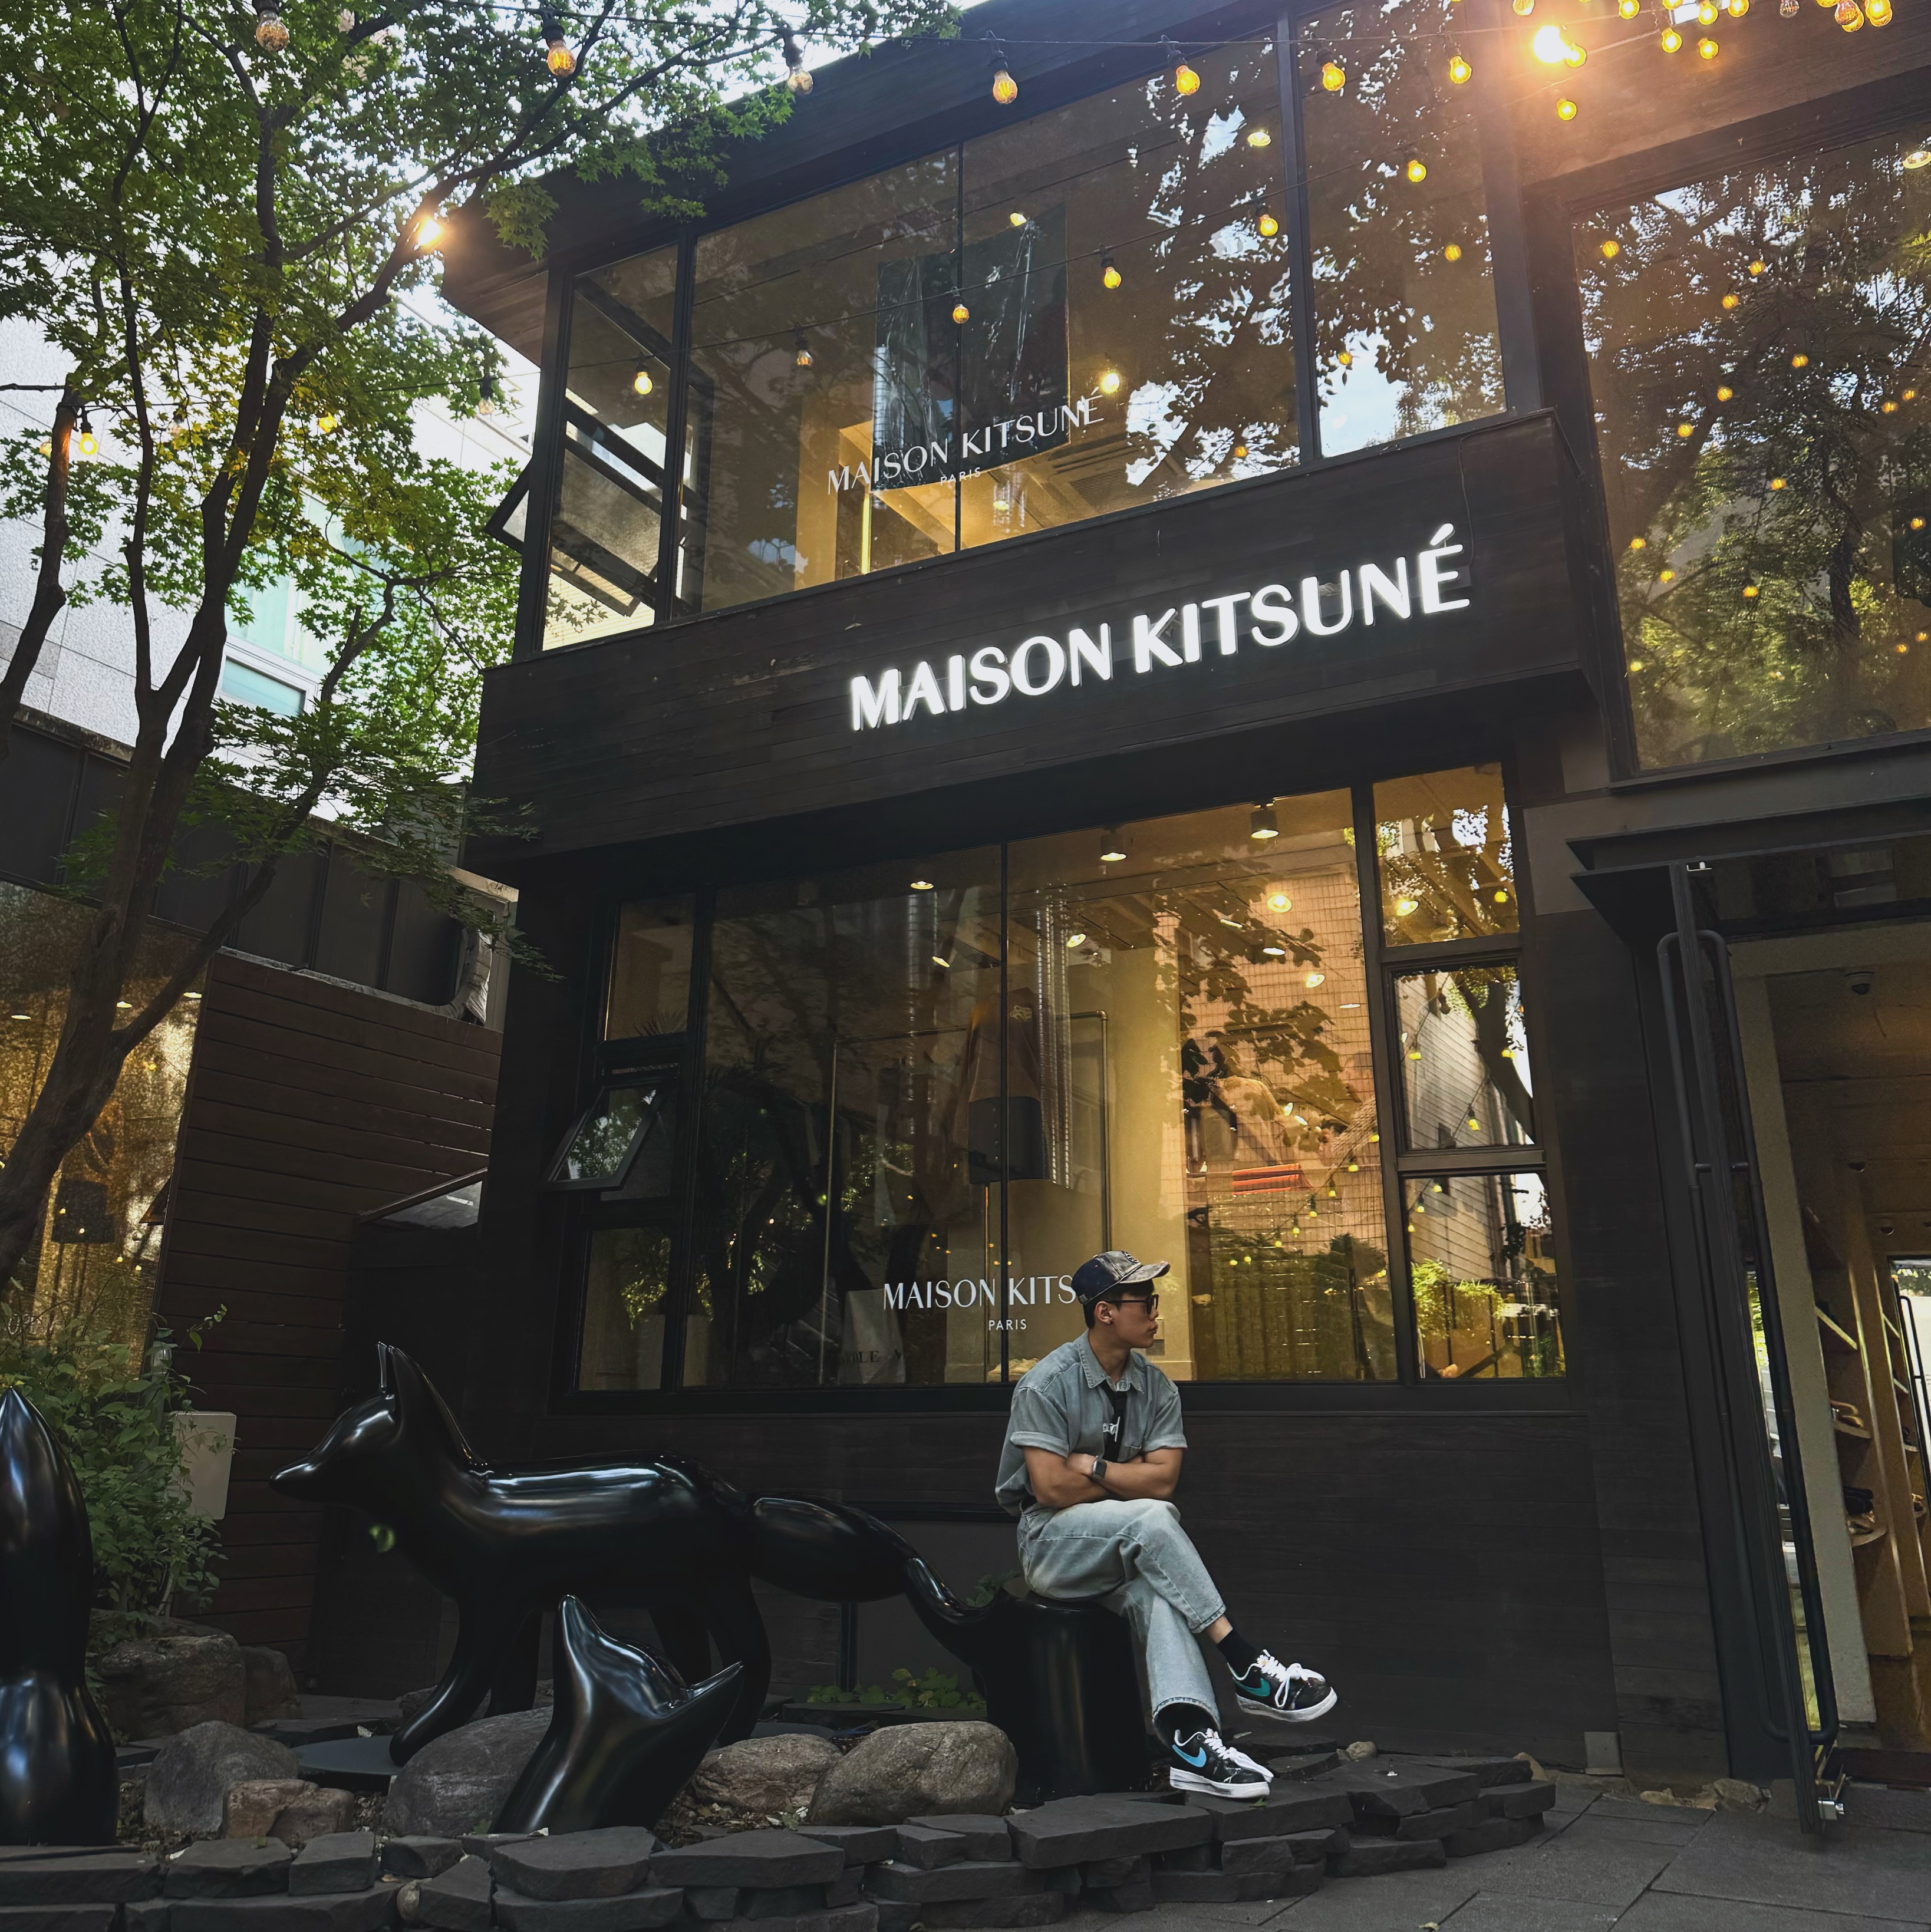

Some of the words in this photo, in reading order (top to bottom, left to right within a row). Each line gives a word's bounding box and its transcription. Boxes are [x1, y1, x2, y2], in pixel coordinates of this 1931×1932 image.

[828, 437, 948, 494] MAISON
[962, 387, 1104, 457] KITSUNÉ
[940, 467, 981, 486] PARIS
[852, 622, 1112, 731] MAISON
[1133, 523, 1470, 673] KITSUNÉ
[884, 1278, 996, 1310] MAISON
[988, 1318, 1027, 1331] PARIS
